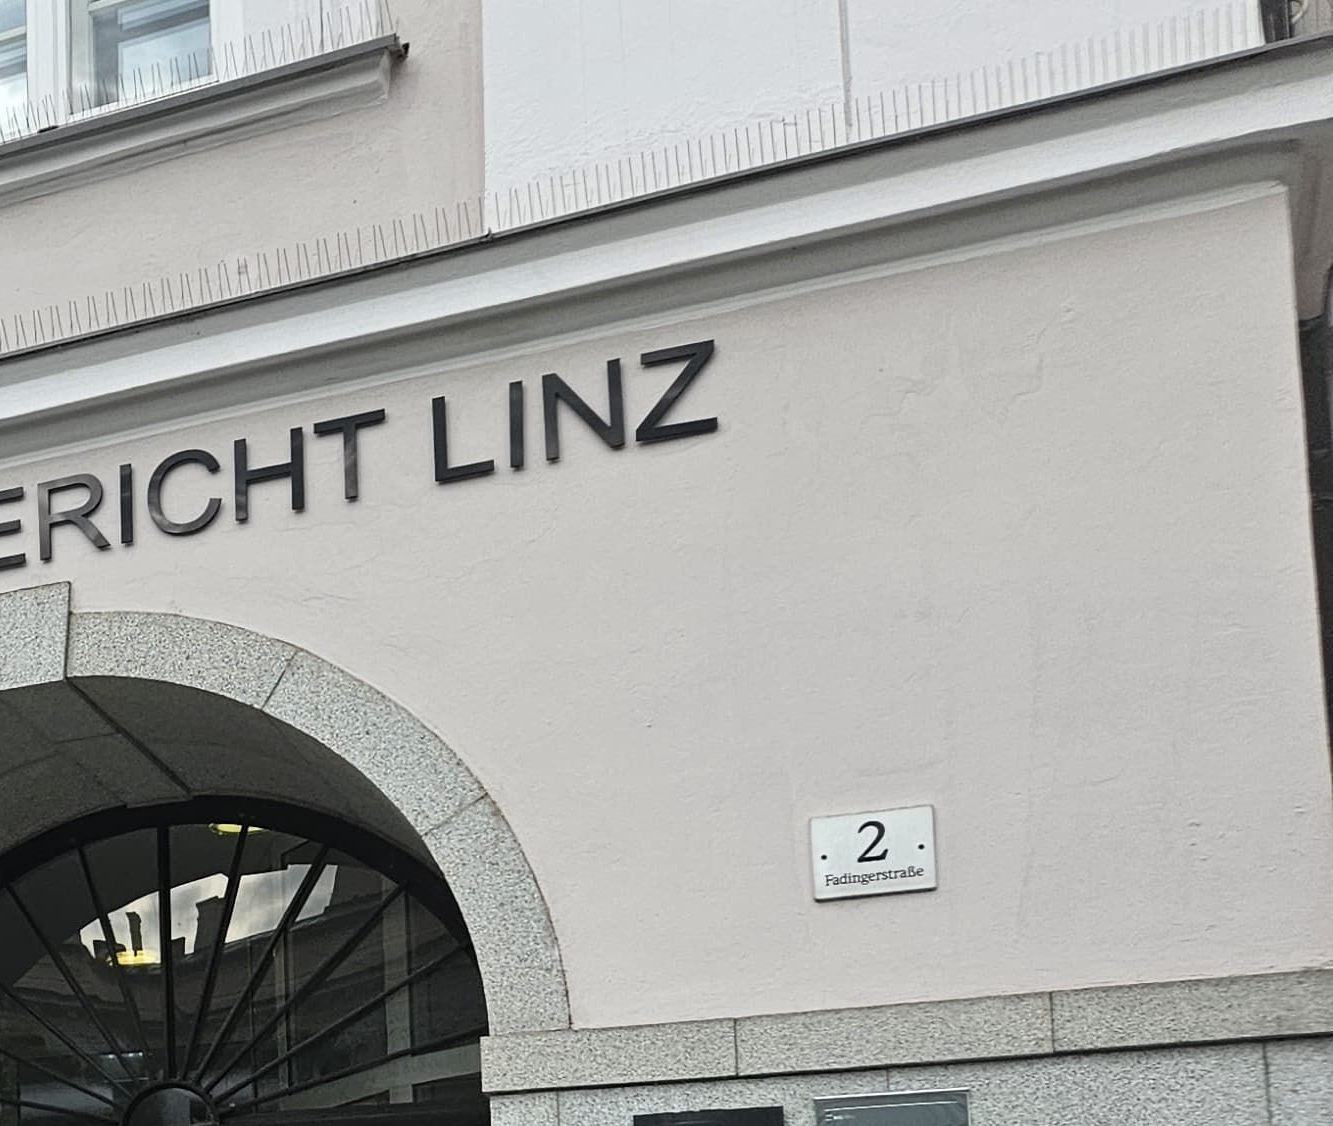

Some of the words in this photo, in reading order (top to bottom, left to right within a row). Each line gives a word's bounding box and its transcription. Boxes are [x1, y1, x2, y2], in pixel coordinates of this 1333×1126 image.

[432, 338, 718, 484] LINZ
[857, 820, 889, 863] 2
[825, 866, 925, 887] Fadingerstraße
